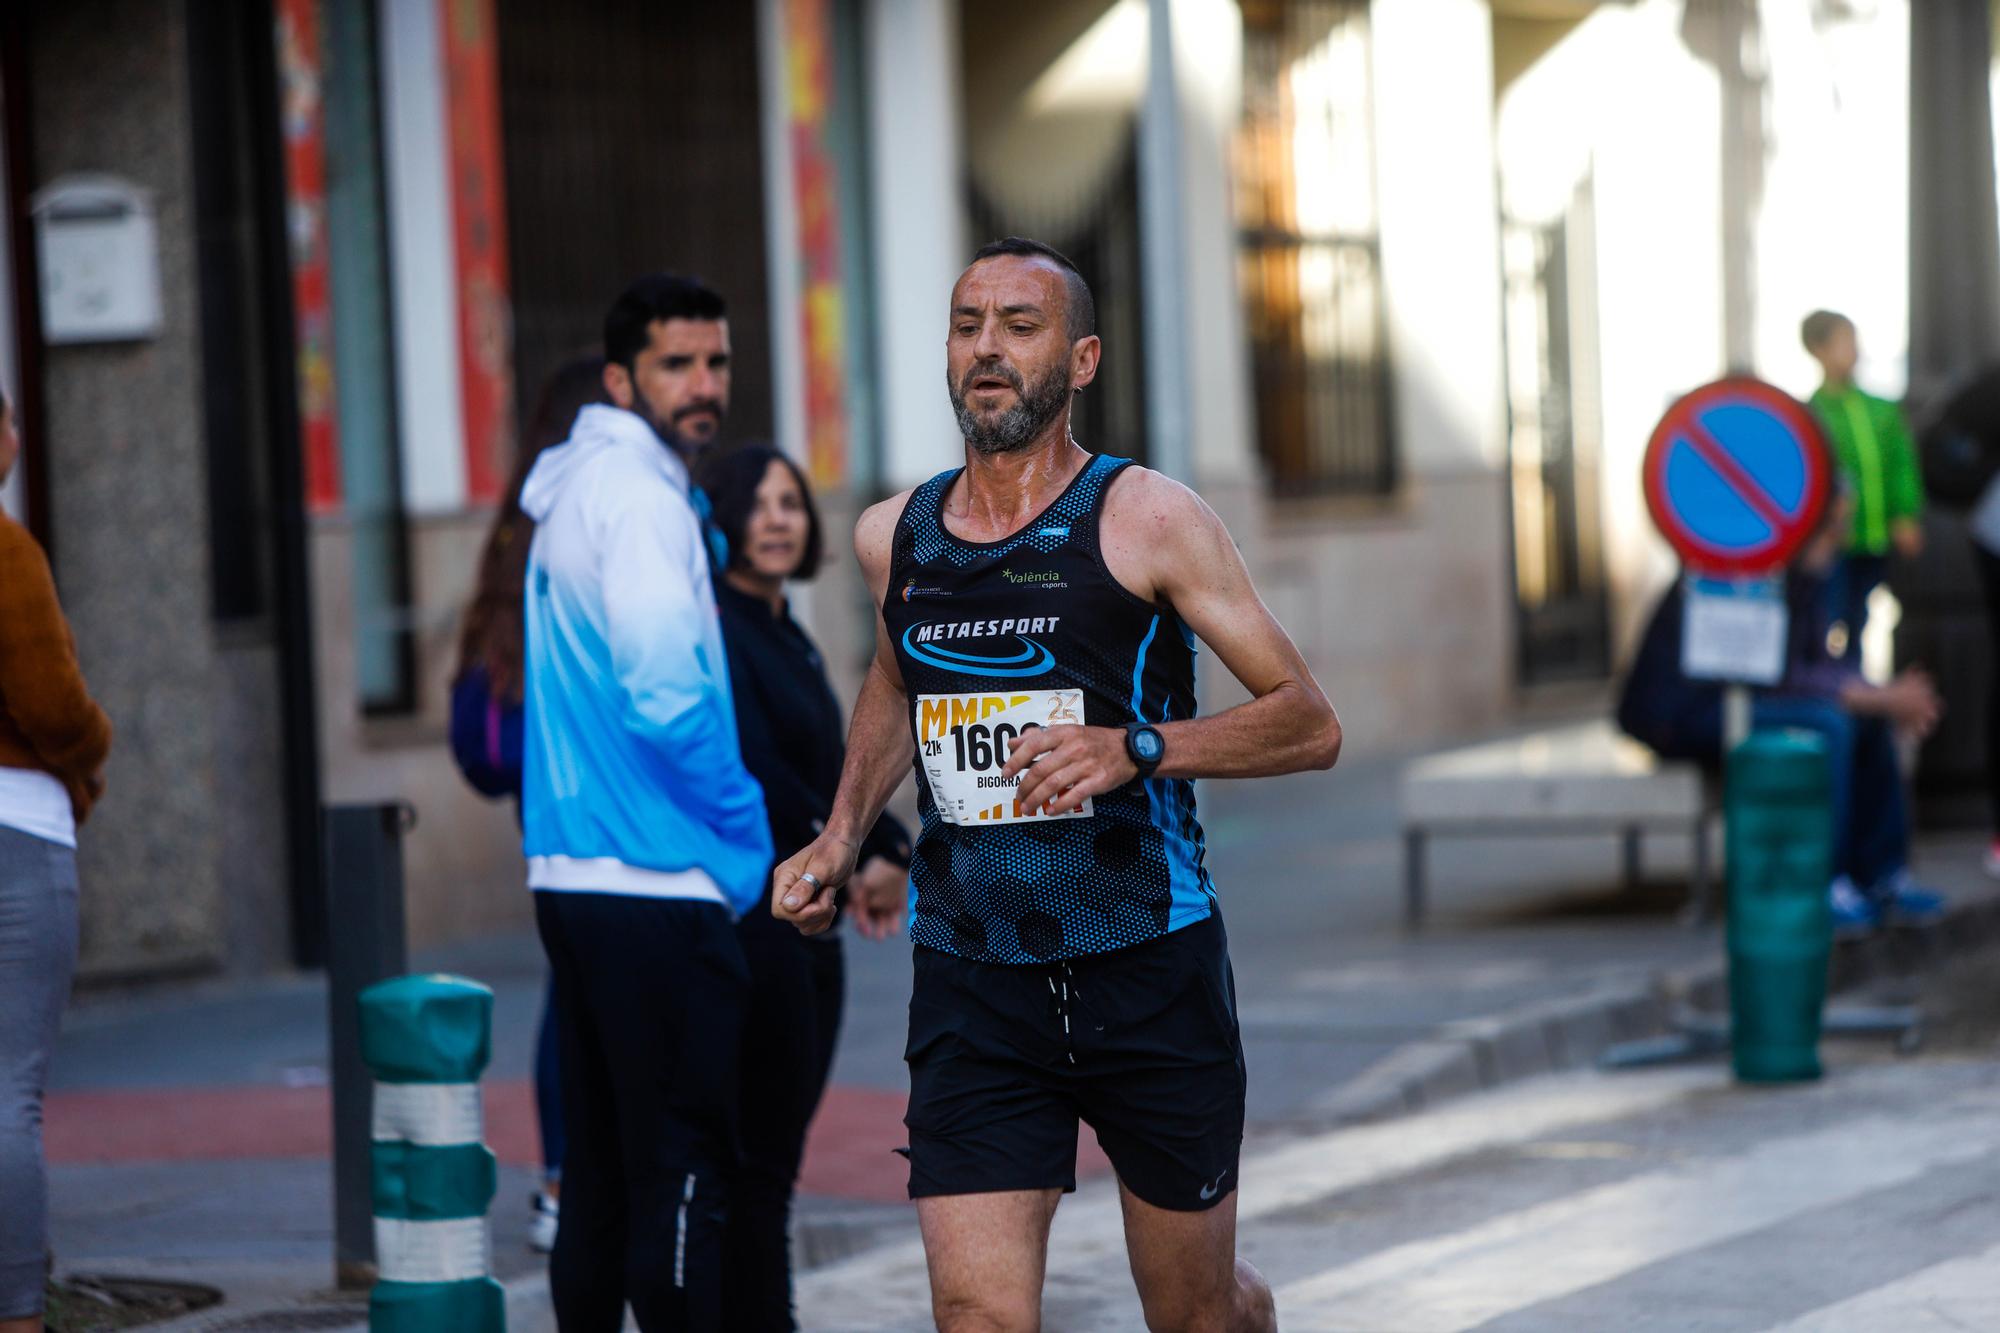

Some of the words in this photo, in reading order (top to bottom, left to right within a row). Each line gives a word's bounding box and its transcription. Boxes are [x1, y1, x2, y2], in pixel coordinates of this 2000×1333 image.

[1010, 571, 1060, 583] València
[916, 617, 1060, 642] METAESPORT
[977, 776, 1021, 788] BIGORRA
